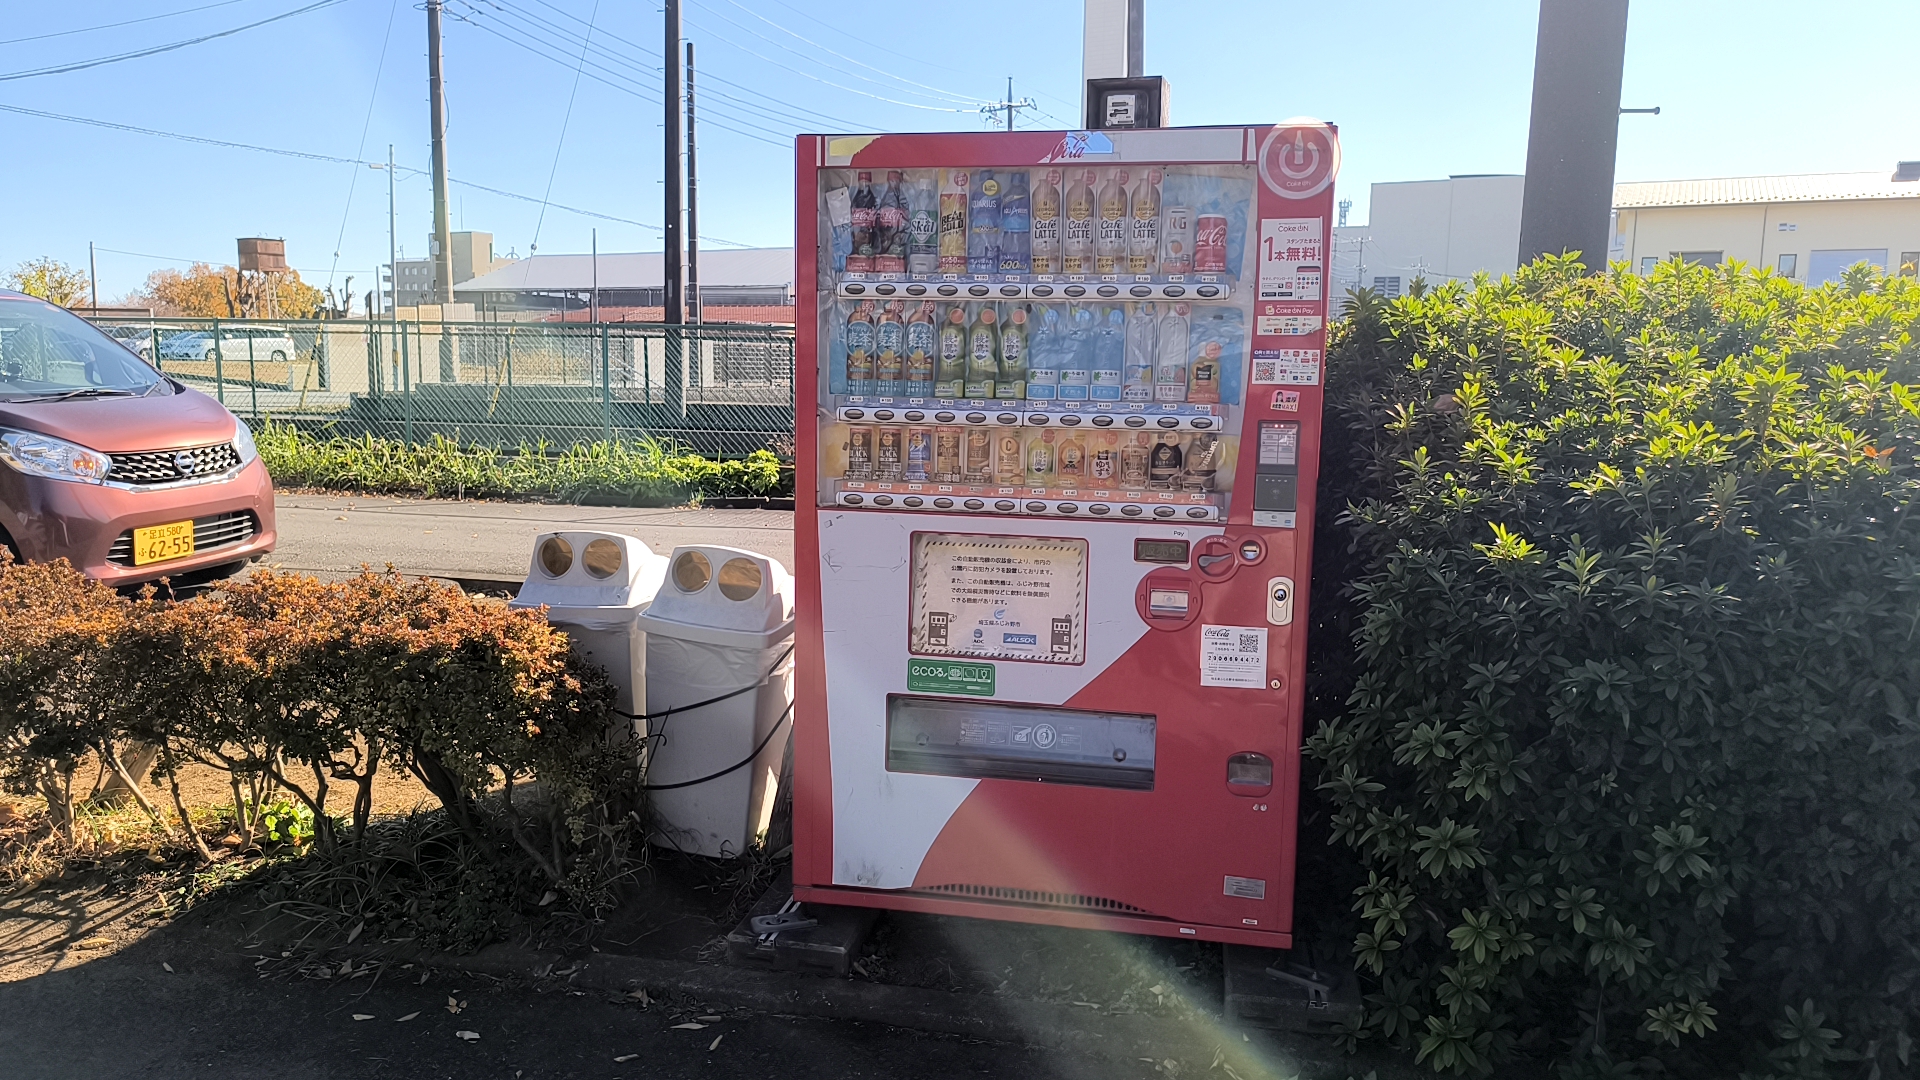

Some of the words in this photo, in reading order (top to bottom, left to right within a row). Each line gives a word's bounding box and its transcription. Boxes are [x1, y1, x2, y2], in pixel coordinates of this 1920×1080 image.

[972, 200, 997, 208] QUARIUS
[941, 211, 963, 224] REAL
[942, 219, 964, 233] GOLD
[1035, 220, 1056, 229] Café
[1068, 220, 1090, 229] Café
[1100, 220, 1122, 229] Café
[1133, 219, 1155, 229] Café
[1277, 225, 1297, 233] Coke
[1298, 224, 1309, 232] ON
[1034, 229, 1056, 239] LATTE
[1067, 229, 1090, 239] LATTE
[1100, 229, 1123, 239] LATTE
[1133, 229, 1155, 239] LATTE
[848, 331, 872, 347] 麦茶
[149, 529, 165, 539] 足立
[167, 526, 181, 536] 580
[148, 536, 190, 559] 62-55
[978, 619, 1021, 628] 埼玉県ふじみ野市
